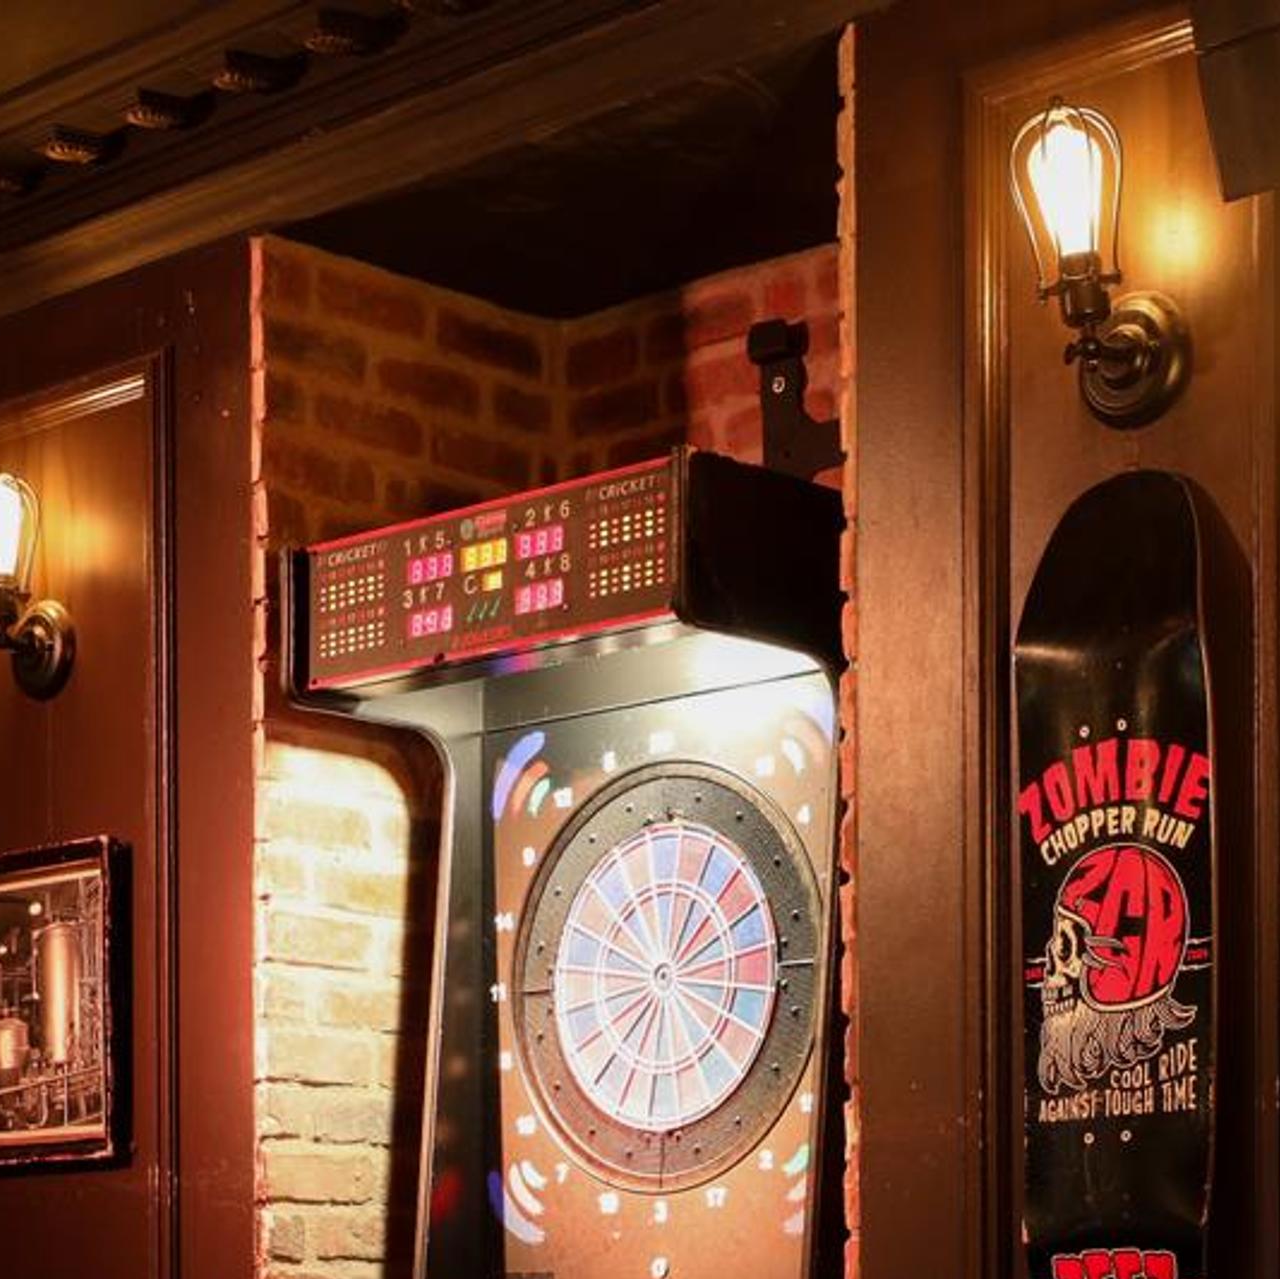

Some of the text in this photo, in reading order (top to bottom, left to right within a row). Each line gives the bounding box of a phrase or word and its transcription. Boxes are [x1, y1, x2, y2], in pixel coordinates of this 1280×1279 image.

[1017, 738, 1210, 844] ZOMBIE
[1041, 806, 1195, 866] CHOPPER RUN
[1110, 1038, 1198, 1088] COOL RIDE
[1038, 1075, 1198, 1123] AGAINST TOUGH TIME
